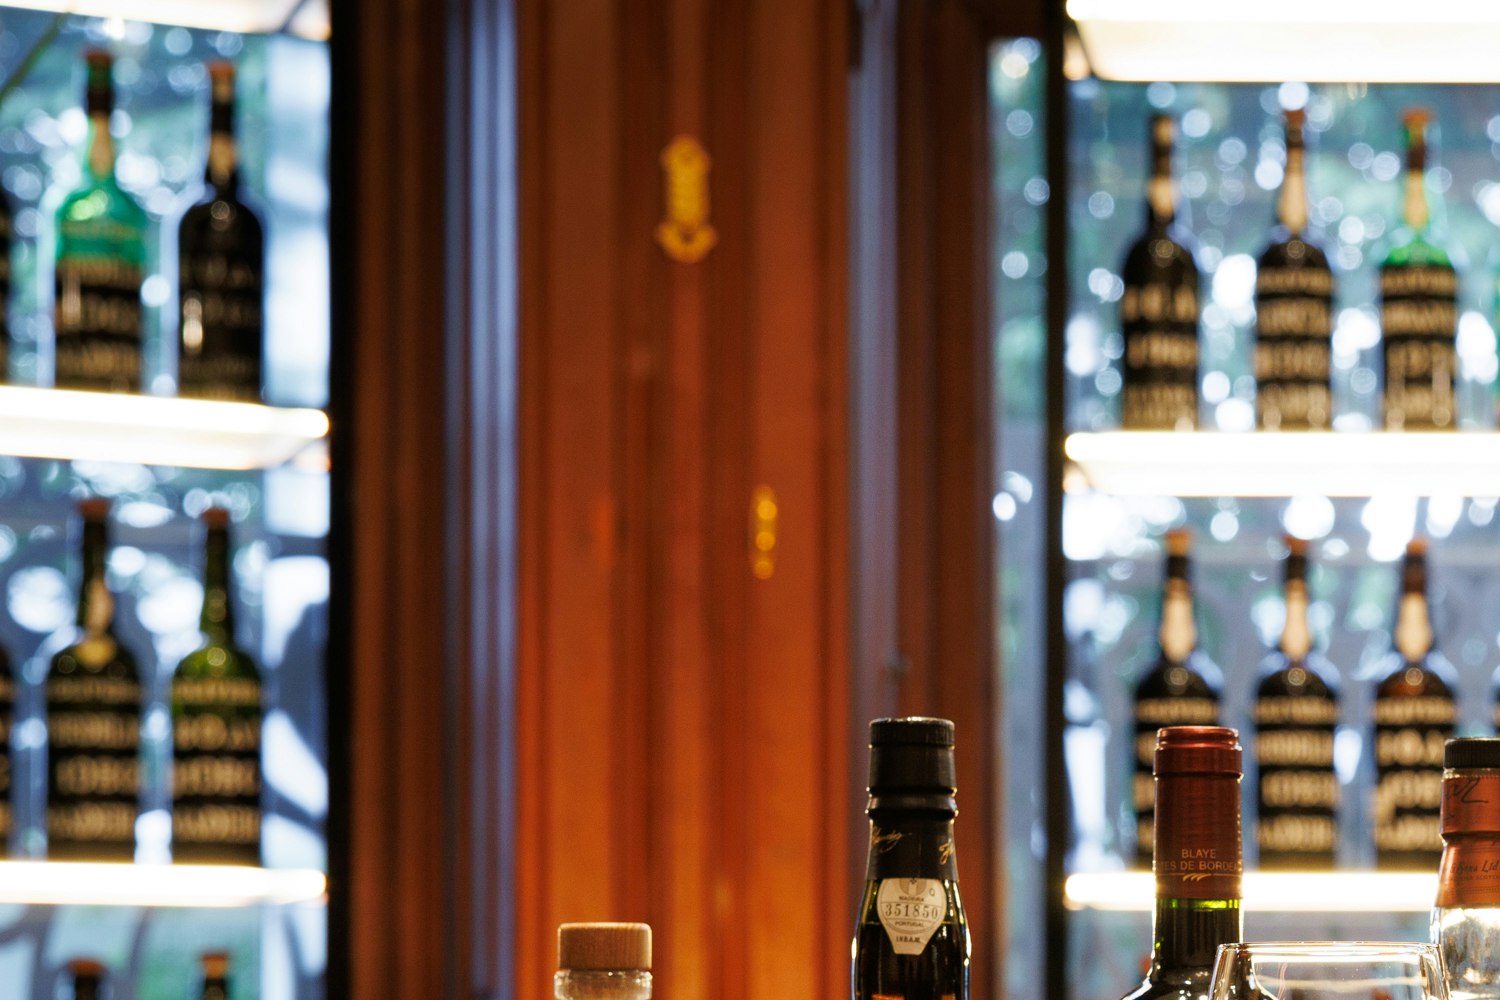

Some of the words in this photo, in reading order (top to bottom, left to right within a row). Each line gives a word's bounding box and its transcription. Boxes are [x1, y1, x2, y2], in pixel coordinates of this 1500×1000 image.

[1181, 849, 1216, 859] BLAYE
[1180, 861, 1194, 871] DE
[885, 903, 938, 919] 351850
